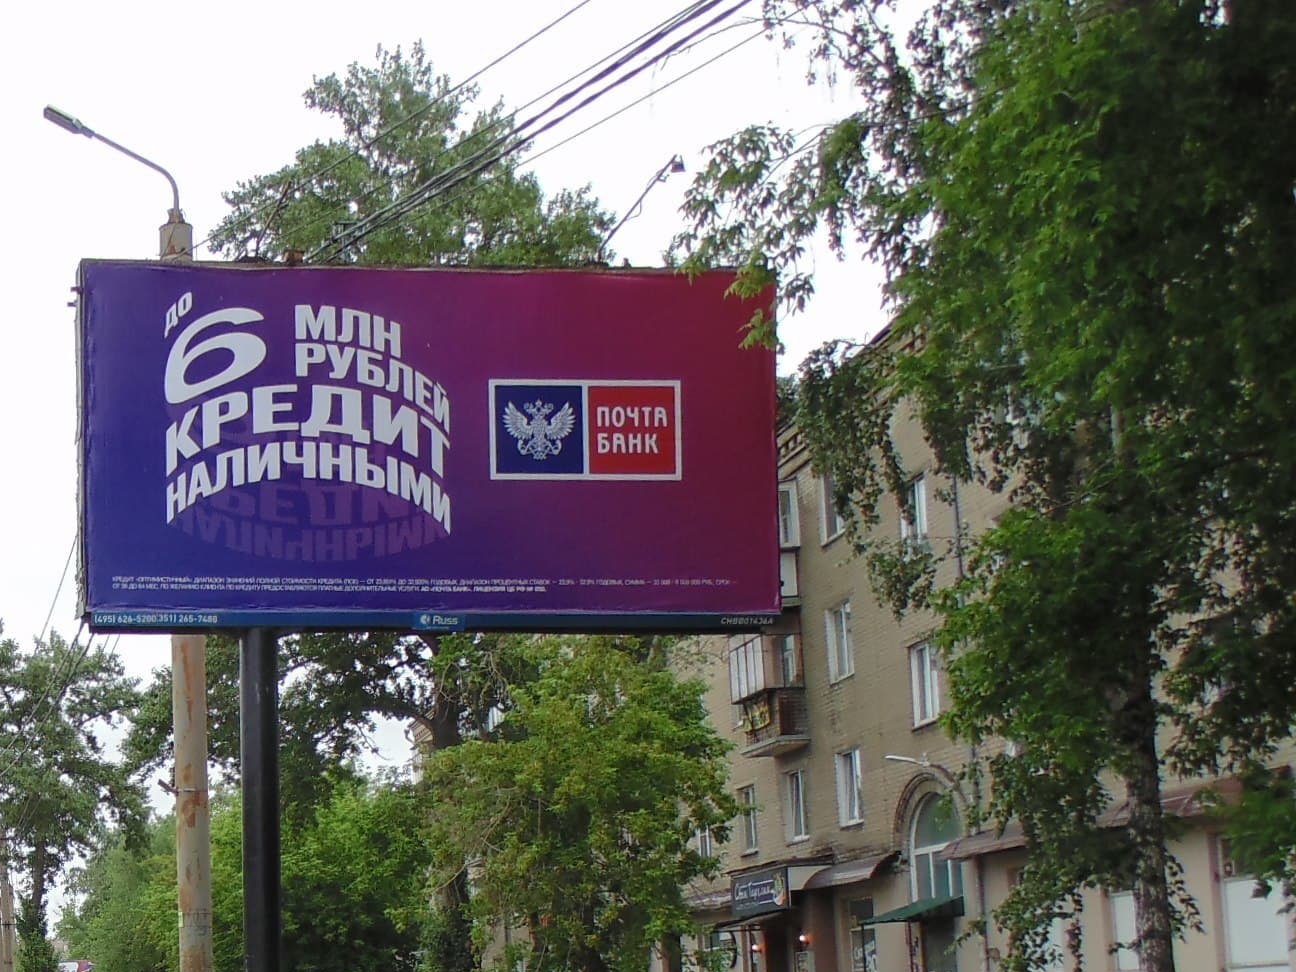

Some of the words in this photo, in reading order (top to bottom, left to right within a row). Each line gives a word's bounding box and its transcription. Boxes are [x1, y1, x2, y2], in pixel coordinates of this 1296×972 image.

[164, 291, 193, 338] ДО
[294, 304, 401, 358] МЛН
[164, 307, 266, 404] 6
[295, 342, 450, 434] РУБЛЕЙ
[166, 384, 450, 478] КРЕДИТ
[597, 406, 668, 428] ПОЧТА
[597, 432, 659, 454] БАНК
[166, 441, 451, 536] НАЛИЧНЫМИ
[433, 615, 458, 625] Russ
